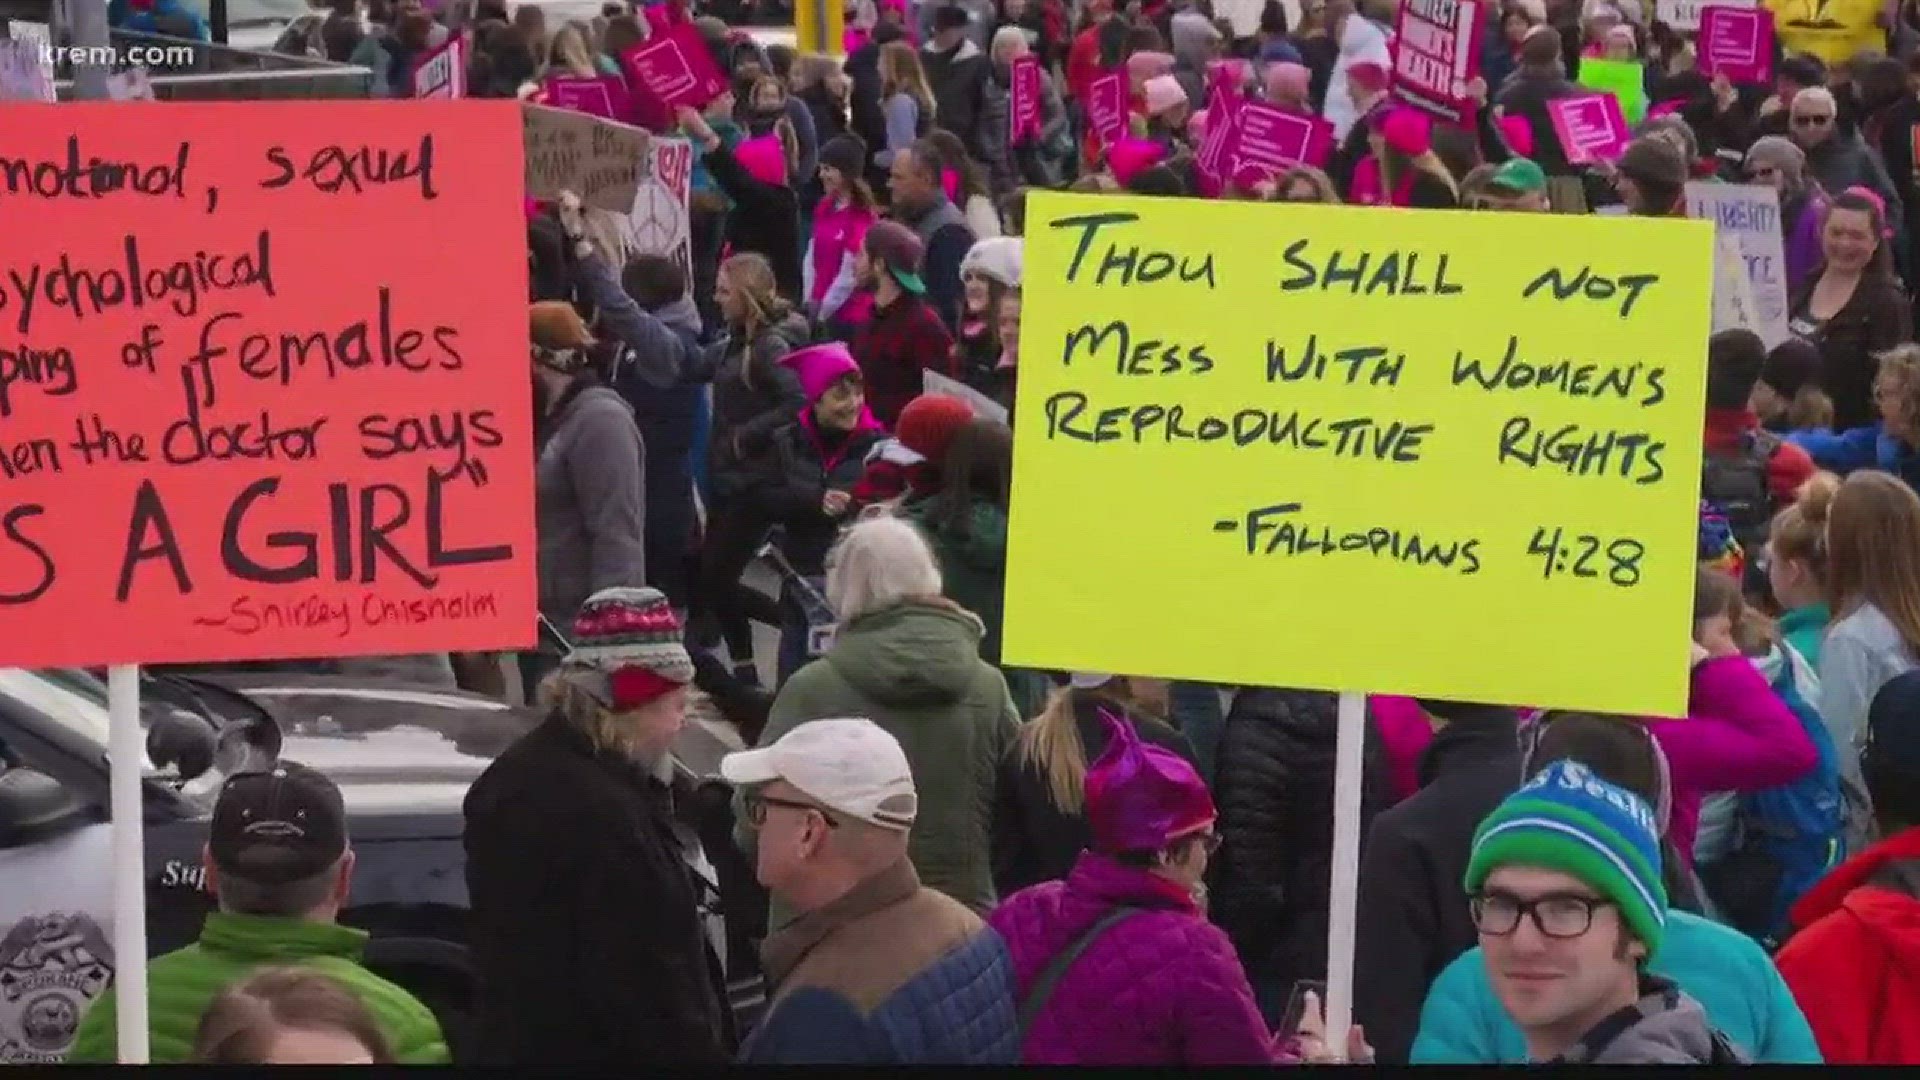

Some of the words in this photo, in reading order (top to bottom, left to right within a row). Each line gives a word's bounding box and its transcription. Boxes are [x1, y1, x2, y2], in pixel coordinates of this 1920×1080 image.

[260, 134, 438, 200] sexual
[1281, 239, 1464, 296] SHALL
[1523, 266, 1660, 317] NOT
[122, 324, 164, 374] of
[189, 286, 463, 408] females
[1063, 321, 1215, 376] MESS
[1266, 334, 1406, 386] WITH
[1452, 336, 1666, 407] WOMEN'S
[71, 413, 150, 465] the
[162, 364, 328, 464] doctor
[358, 410, 503, 484] says
[1045, 391, 1435, 462] REPRODUCTIVE
[1499, 417, 1666, 485] RIGHTS
[117, 478, 193, 602] A
[1527, 526, 1644, 588] 4:28
